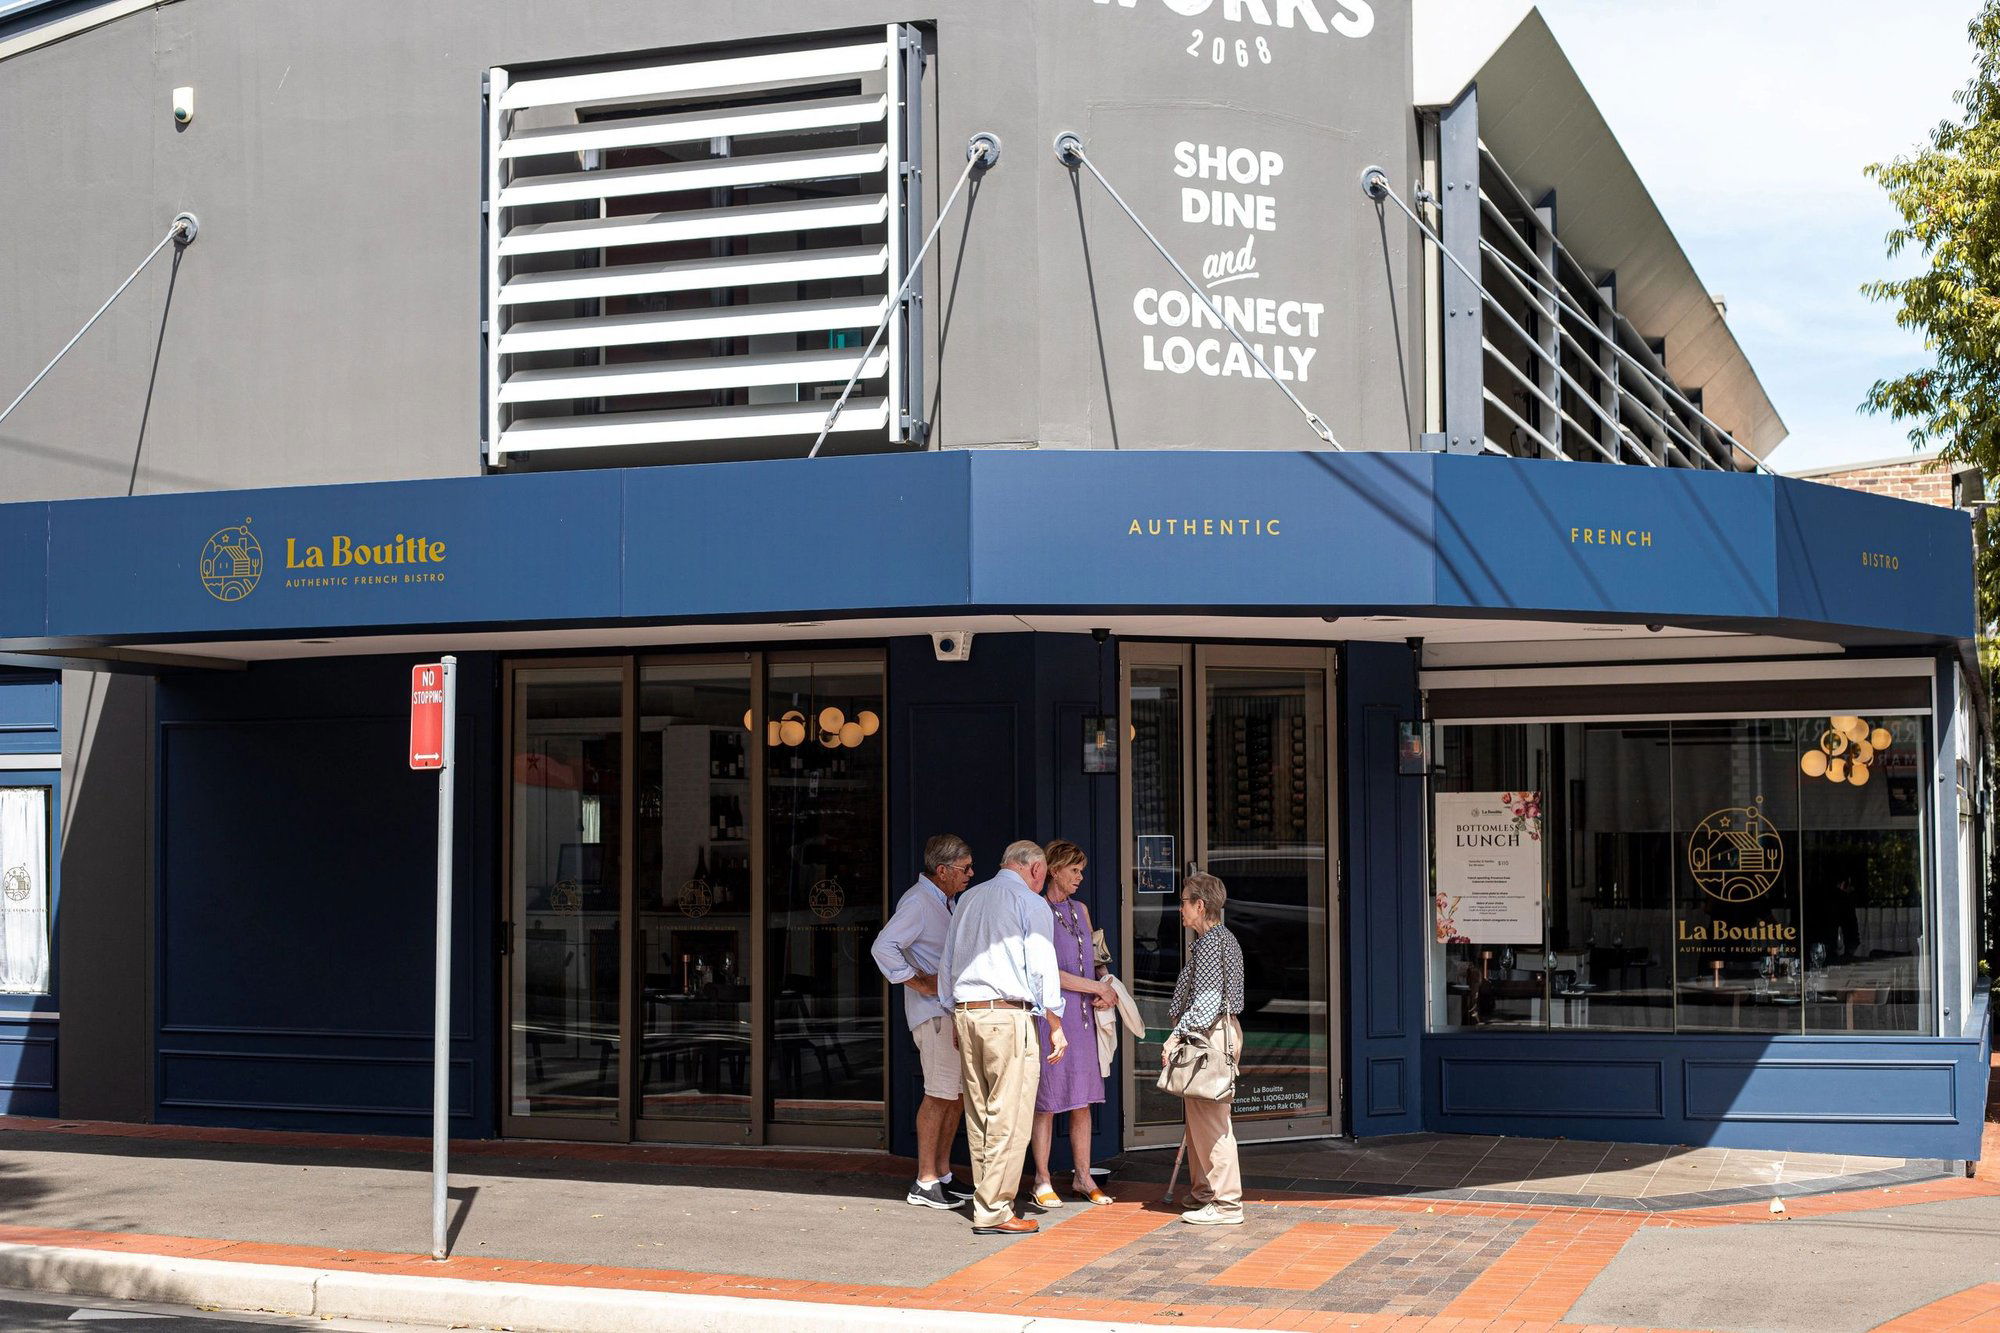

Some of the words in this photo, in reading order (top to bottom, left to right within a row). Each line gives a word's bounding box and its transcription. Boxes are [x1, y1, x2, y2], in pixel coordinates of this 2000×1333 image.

[1186, 28, 1272, 68] 2068
[1173, 141, 1284, 186] SHOP
[1181, 188, 1277, 231] DINE
[1202, 234, 1257, 281] and
[1133, 287, 1325, 338] CONNECT
[1142, 335, 1317, 382] LOCALLY
[1128, 519, 1281, 536] AUTHENTIC
[1570, 527, 1653, 547] FRENCH
[285, 537, 325, 569] La
[331, 532, 448, 567] Bouitte
[1862, 551, 1900, 571] BISTRO
[285, 577, 349, 588] AUTHENTIC
[353, 574, 399, 586] FRENCH
[403, 572, 446, 584] BISTRO
[421, 670, 435, 687] NO
[413, 689, 443, 705] STOPPING
[1456, 824, 1521, 833] BOTTOMLESS
[1456, 834, 1520, 848] LUNCH
[1679, 920, 1708, 940] La
[1713, 920, 1797, 940] Bouitte
[1251, 1095, 1261, 1103] No.
[1253, 1086, 1261, 1094] La
[1261, 1085, 1284, 1093] Bouitte
[1234, 1104, 1260, 1113] Licensee
[1264, 1103, 1276, 1111] Hoo
[1277, 1102, 1288, 1110] Rak
[1289, 1101, 1303, 1110] Choi
